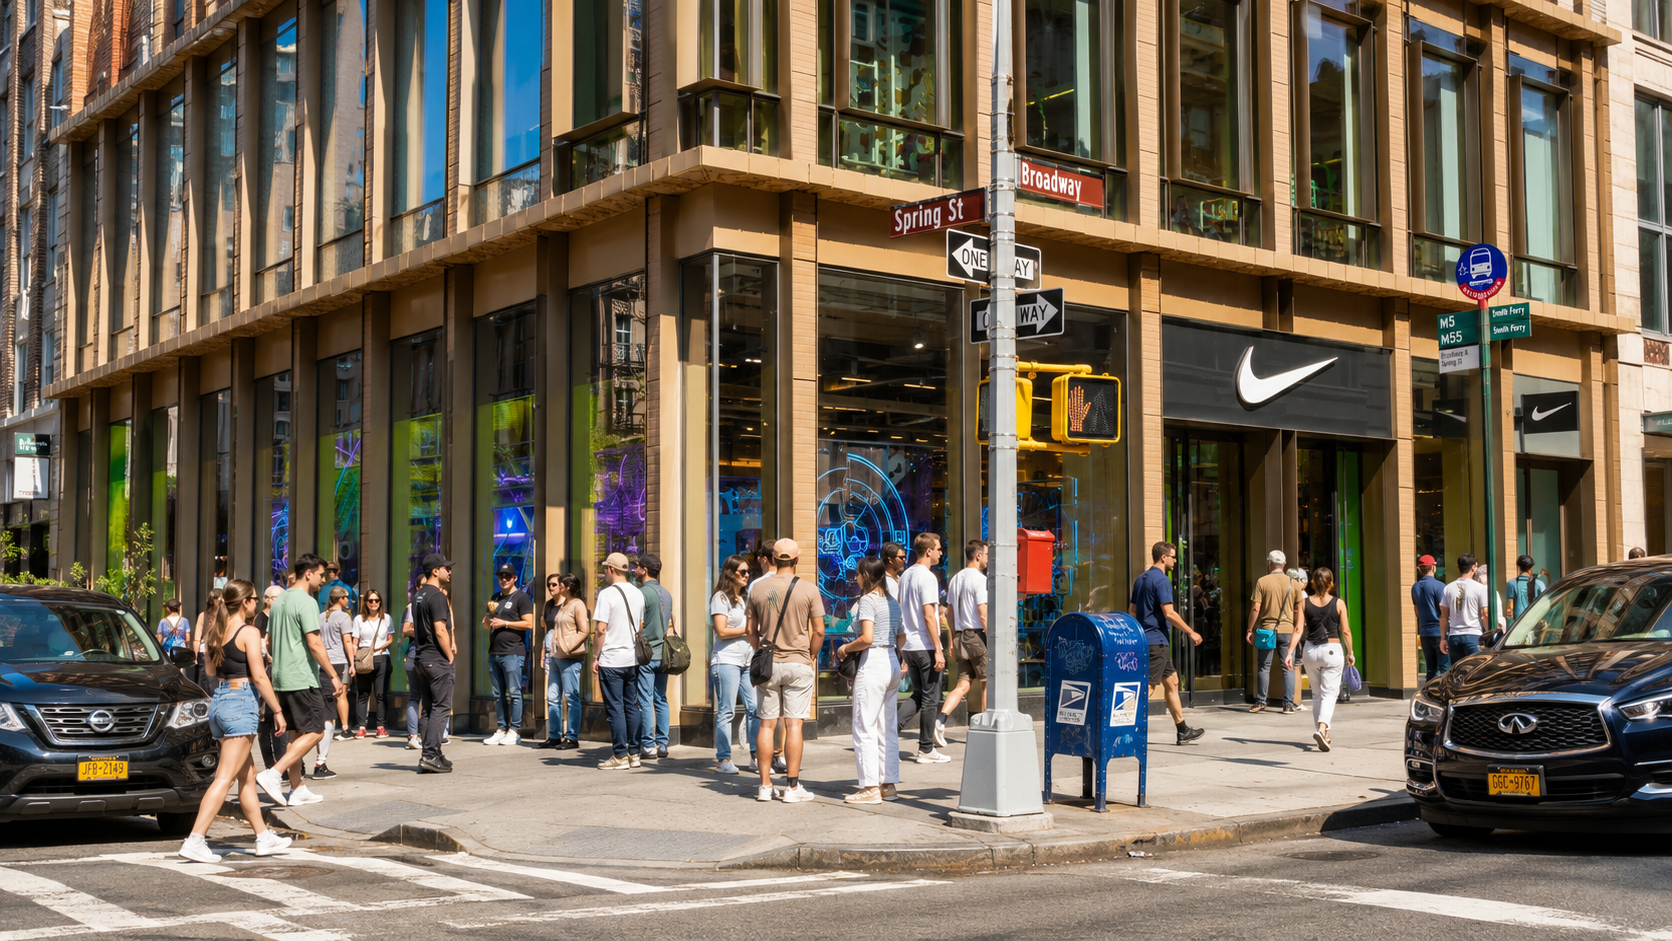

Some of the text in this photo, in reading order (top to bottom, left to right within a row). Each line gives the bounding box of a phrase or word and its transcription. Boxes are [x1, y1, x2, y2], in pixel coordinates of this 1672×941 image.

[1021, 161, 1082, 201] Broadway
[894, 198, 964, 235] Spring St
[961, 248, 1030, 277] ONE AY
[1020, 303, 1048, 324] WAY
[1440, 315, 1456, 329] M5
[1441, 330, 1463, 346] M55
